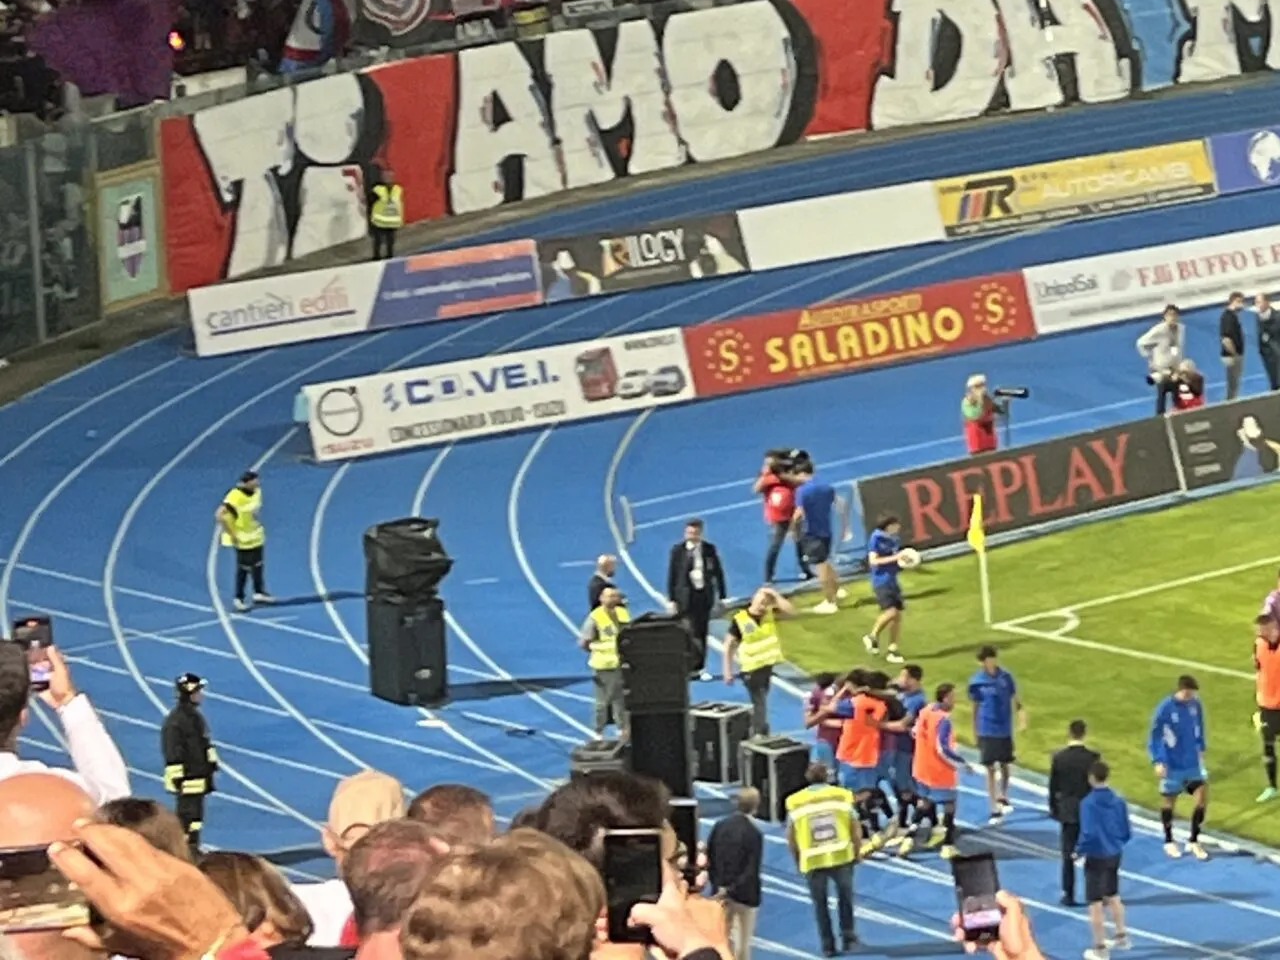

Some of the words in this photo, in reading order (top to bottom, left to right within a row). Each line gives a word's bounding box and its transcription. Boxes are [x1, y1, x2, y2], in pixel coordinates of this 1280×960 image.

[449, 0, 800, 214] AMO
[765, 307, 964, 373] SALADINO
[901, 433, 1130, 542] REPLAY
